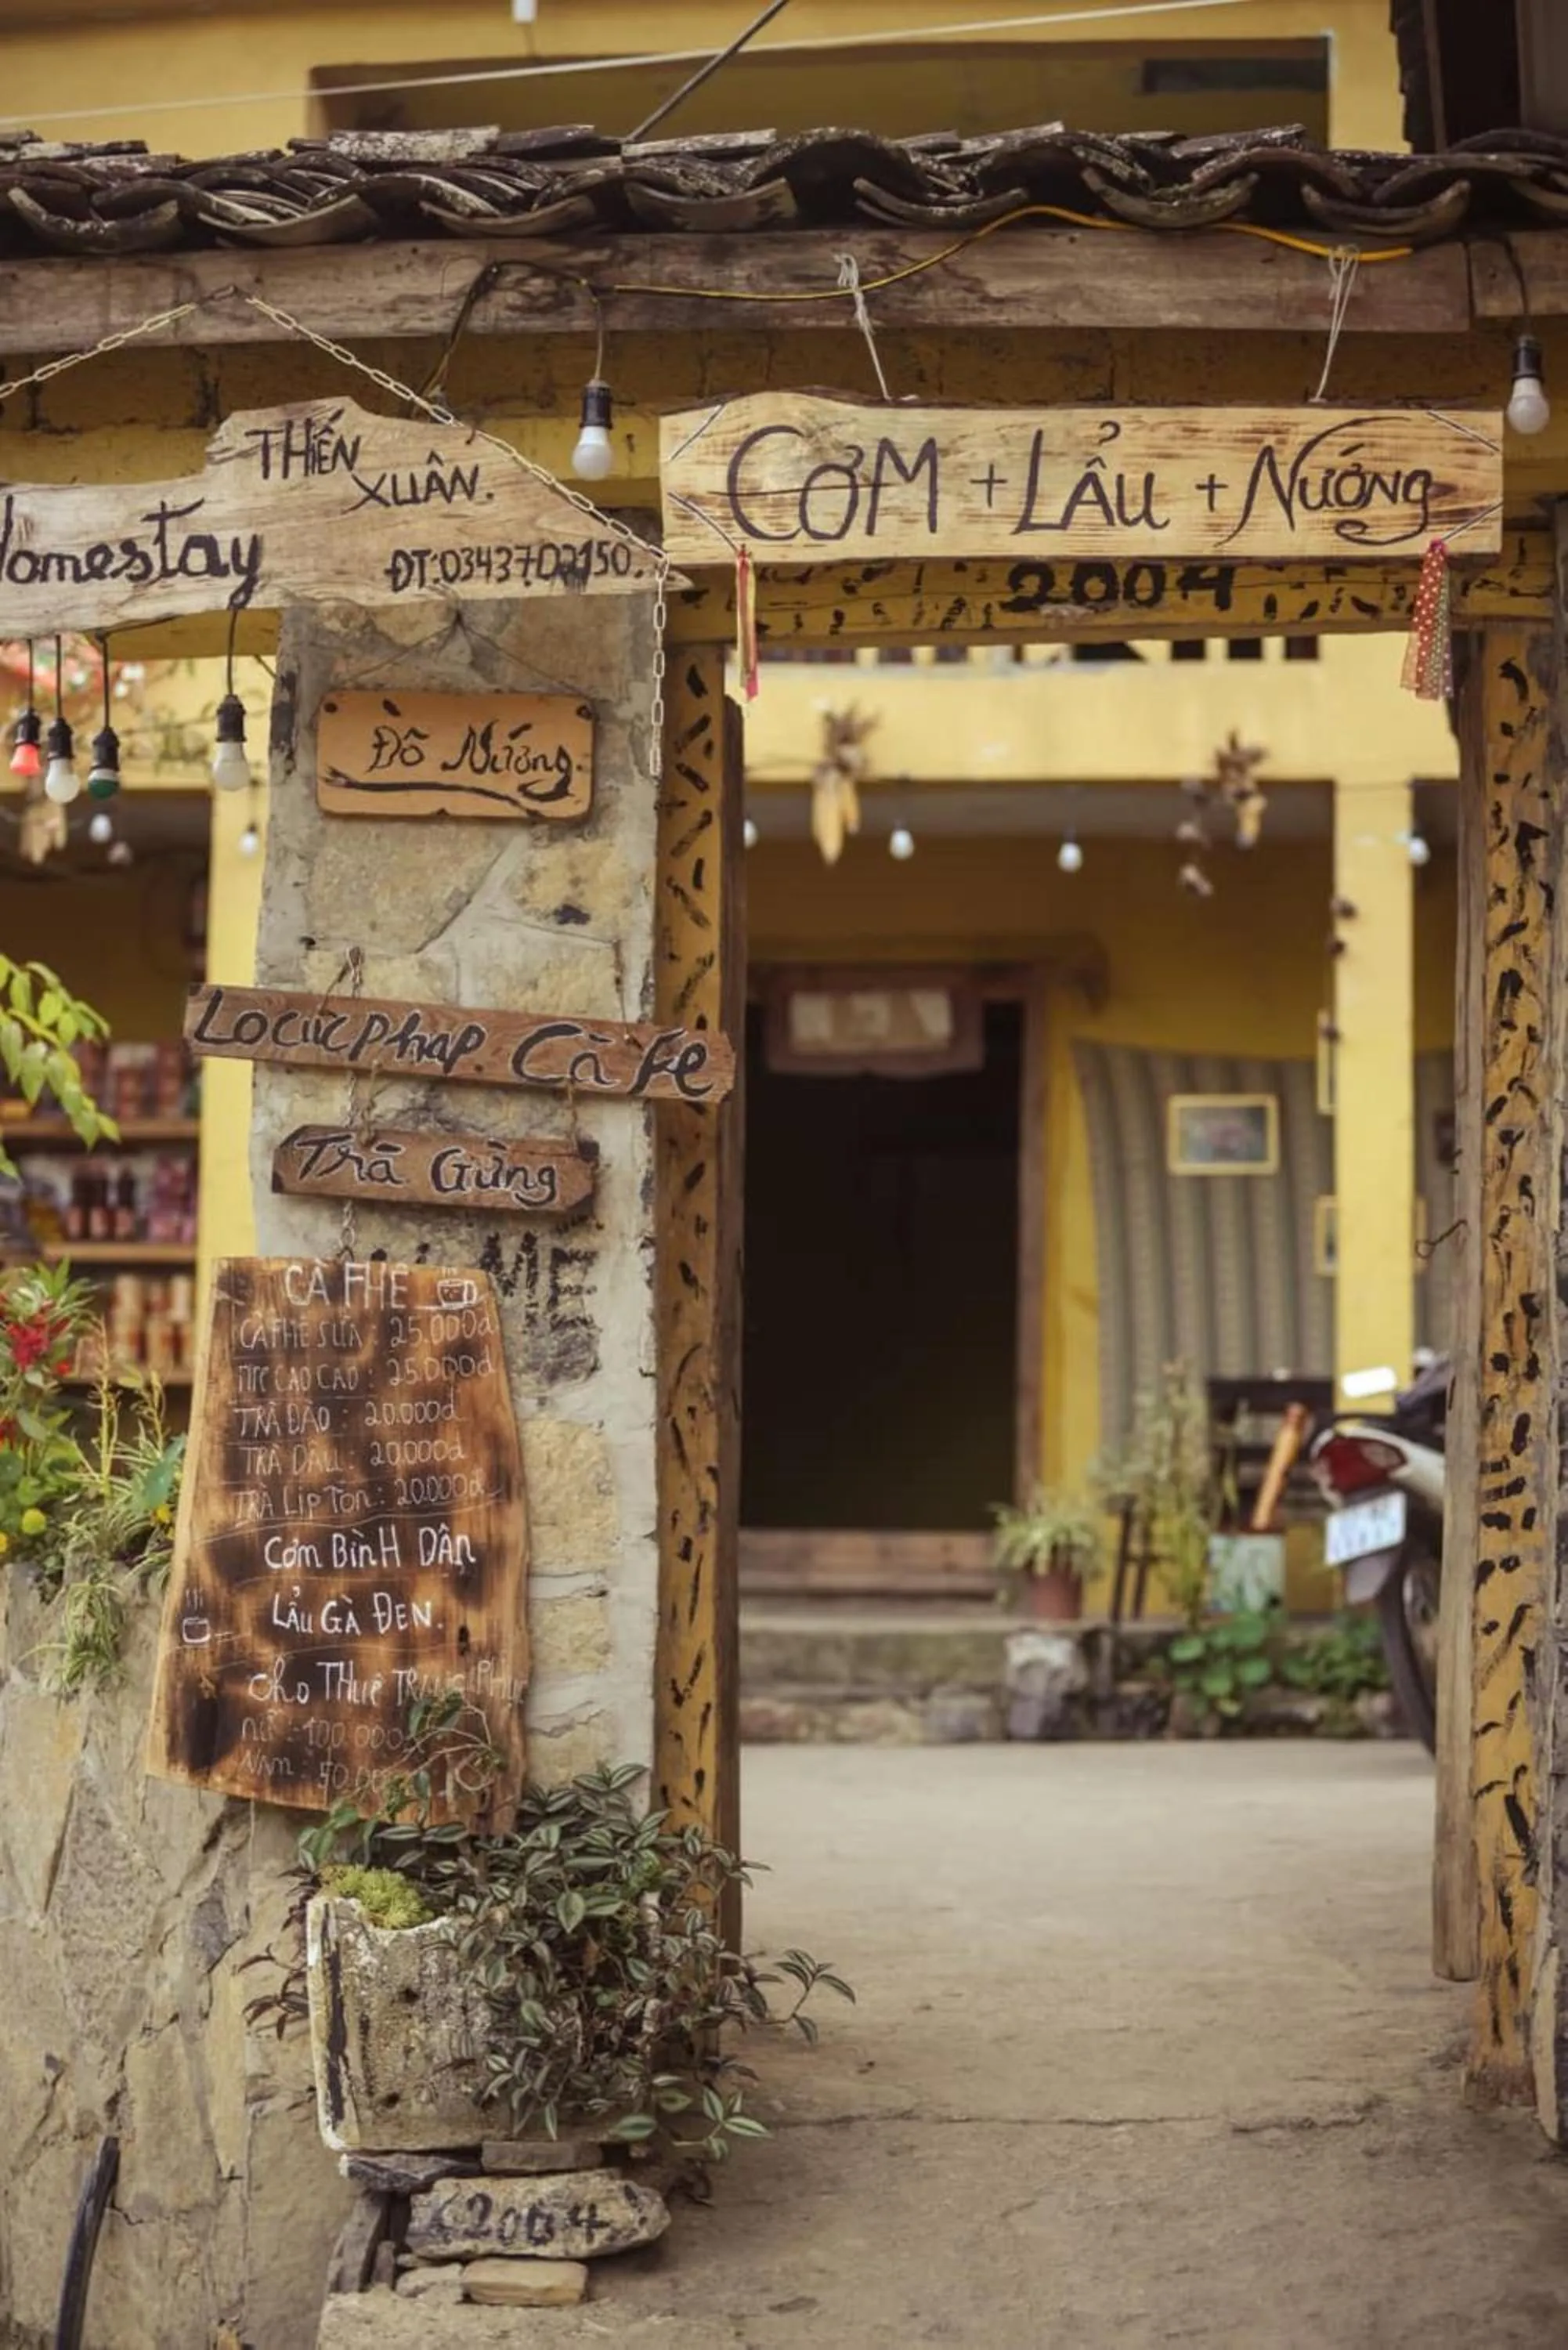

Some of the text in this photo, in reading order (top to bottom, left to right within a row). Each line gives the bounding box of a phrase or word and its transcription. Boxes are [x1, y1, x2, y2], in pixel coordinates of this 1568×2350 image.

[727, 425, 938, 540] CƠM
[1003, 559, 1236, 613] 2004
[320, 1594, 361, 1636] GÀ
